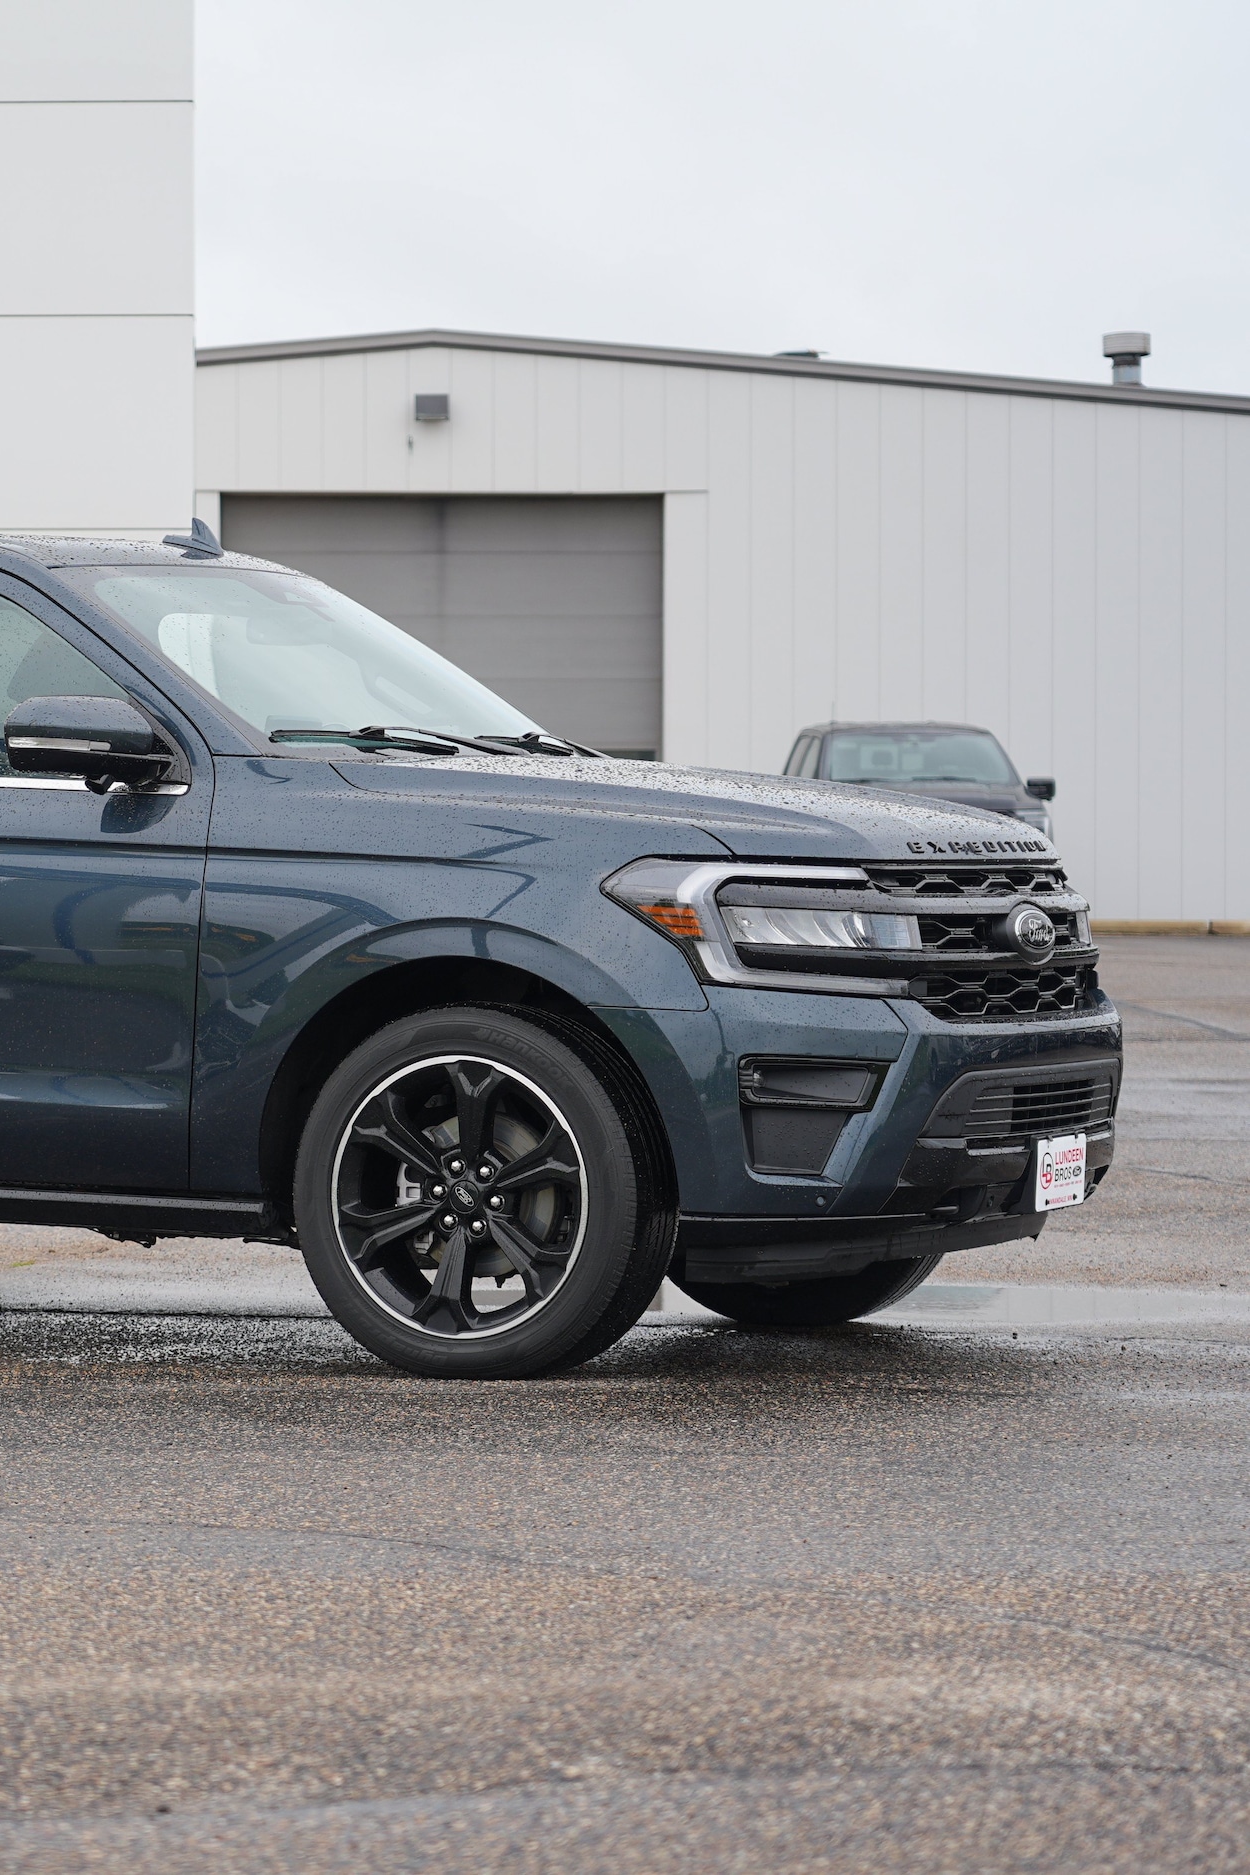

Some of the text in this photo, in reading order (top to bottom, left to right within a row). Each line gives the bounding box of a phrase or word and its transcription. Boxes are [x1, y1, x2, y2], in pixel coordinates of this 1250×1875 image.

[1028, 918, 1052, 942] Ford
[1055, 1147, 1084, 1165] LUNDEEN
[1054, 1166, 1072, 1182] BROS
